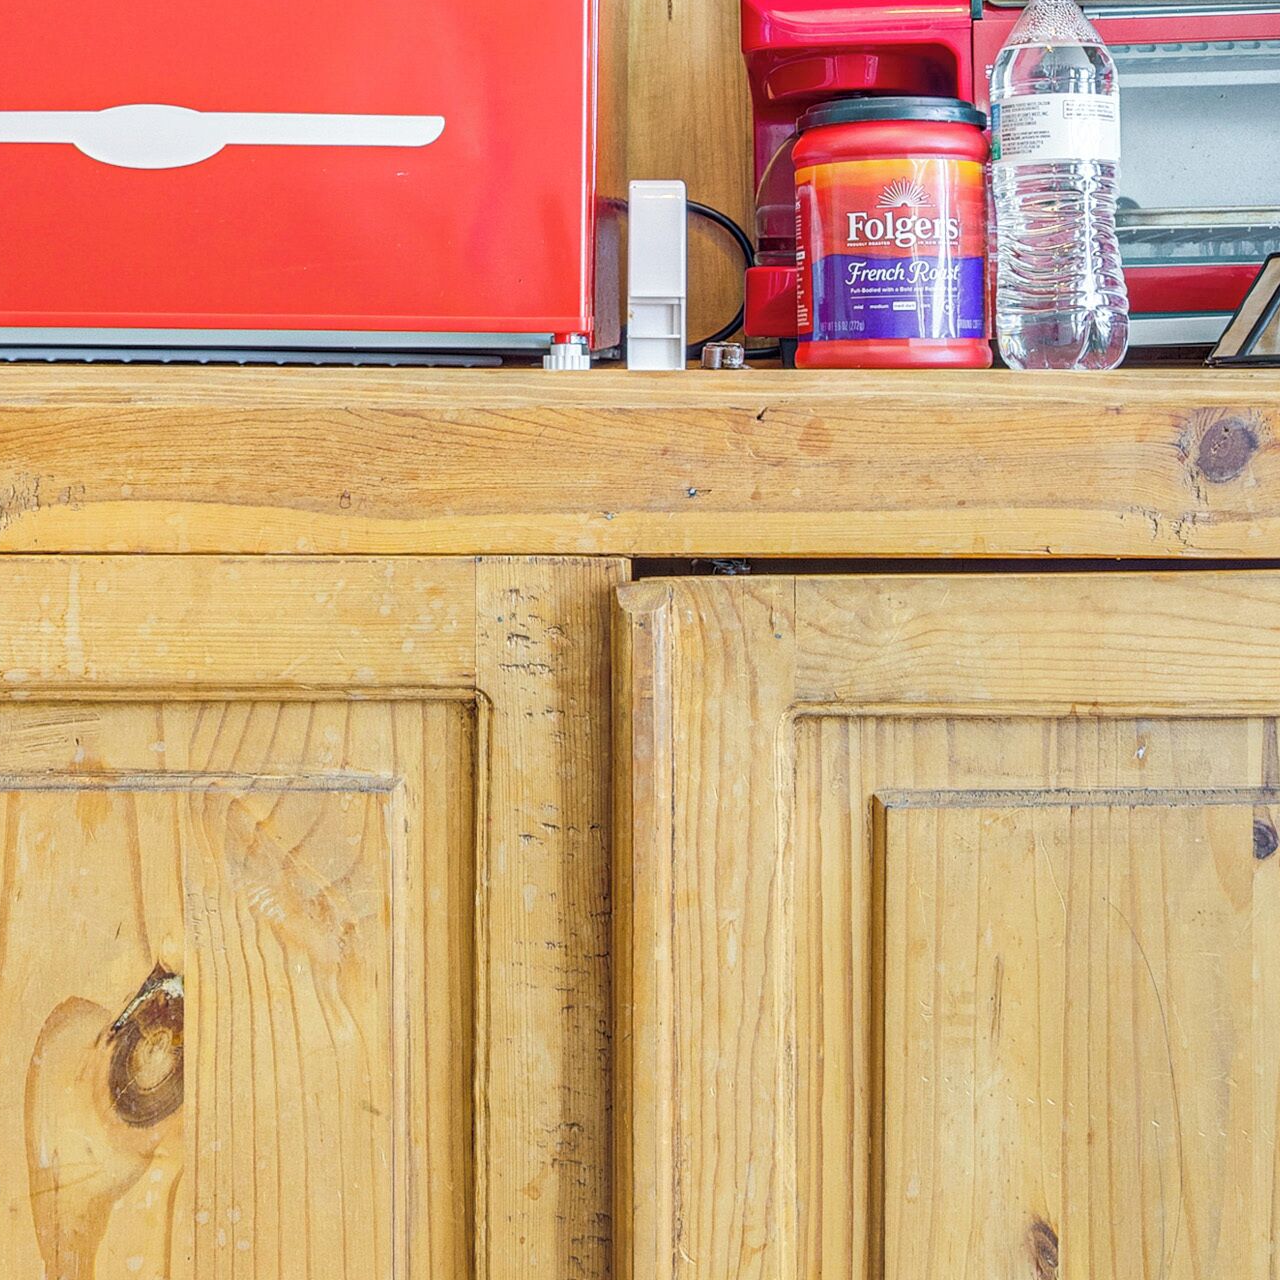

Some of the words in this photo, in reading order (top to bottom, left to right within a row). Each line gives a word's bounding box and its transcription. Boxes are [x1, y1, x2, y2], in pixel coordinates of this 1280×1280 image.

[846, 211, 960, 248] Folgers
[845, 261, 905, 286] French
[906, 260, 960, 284] Roast
